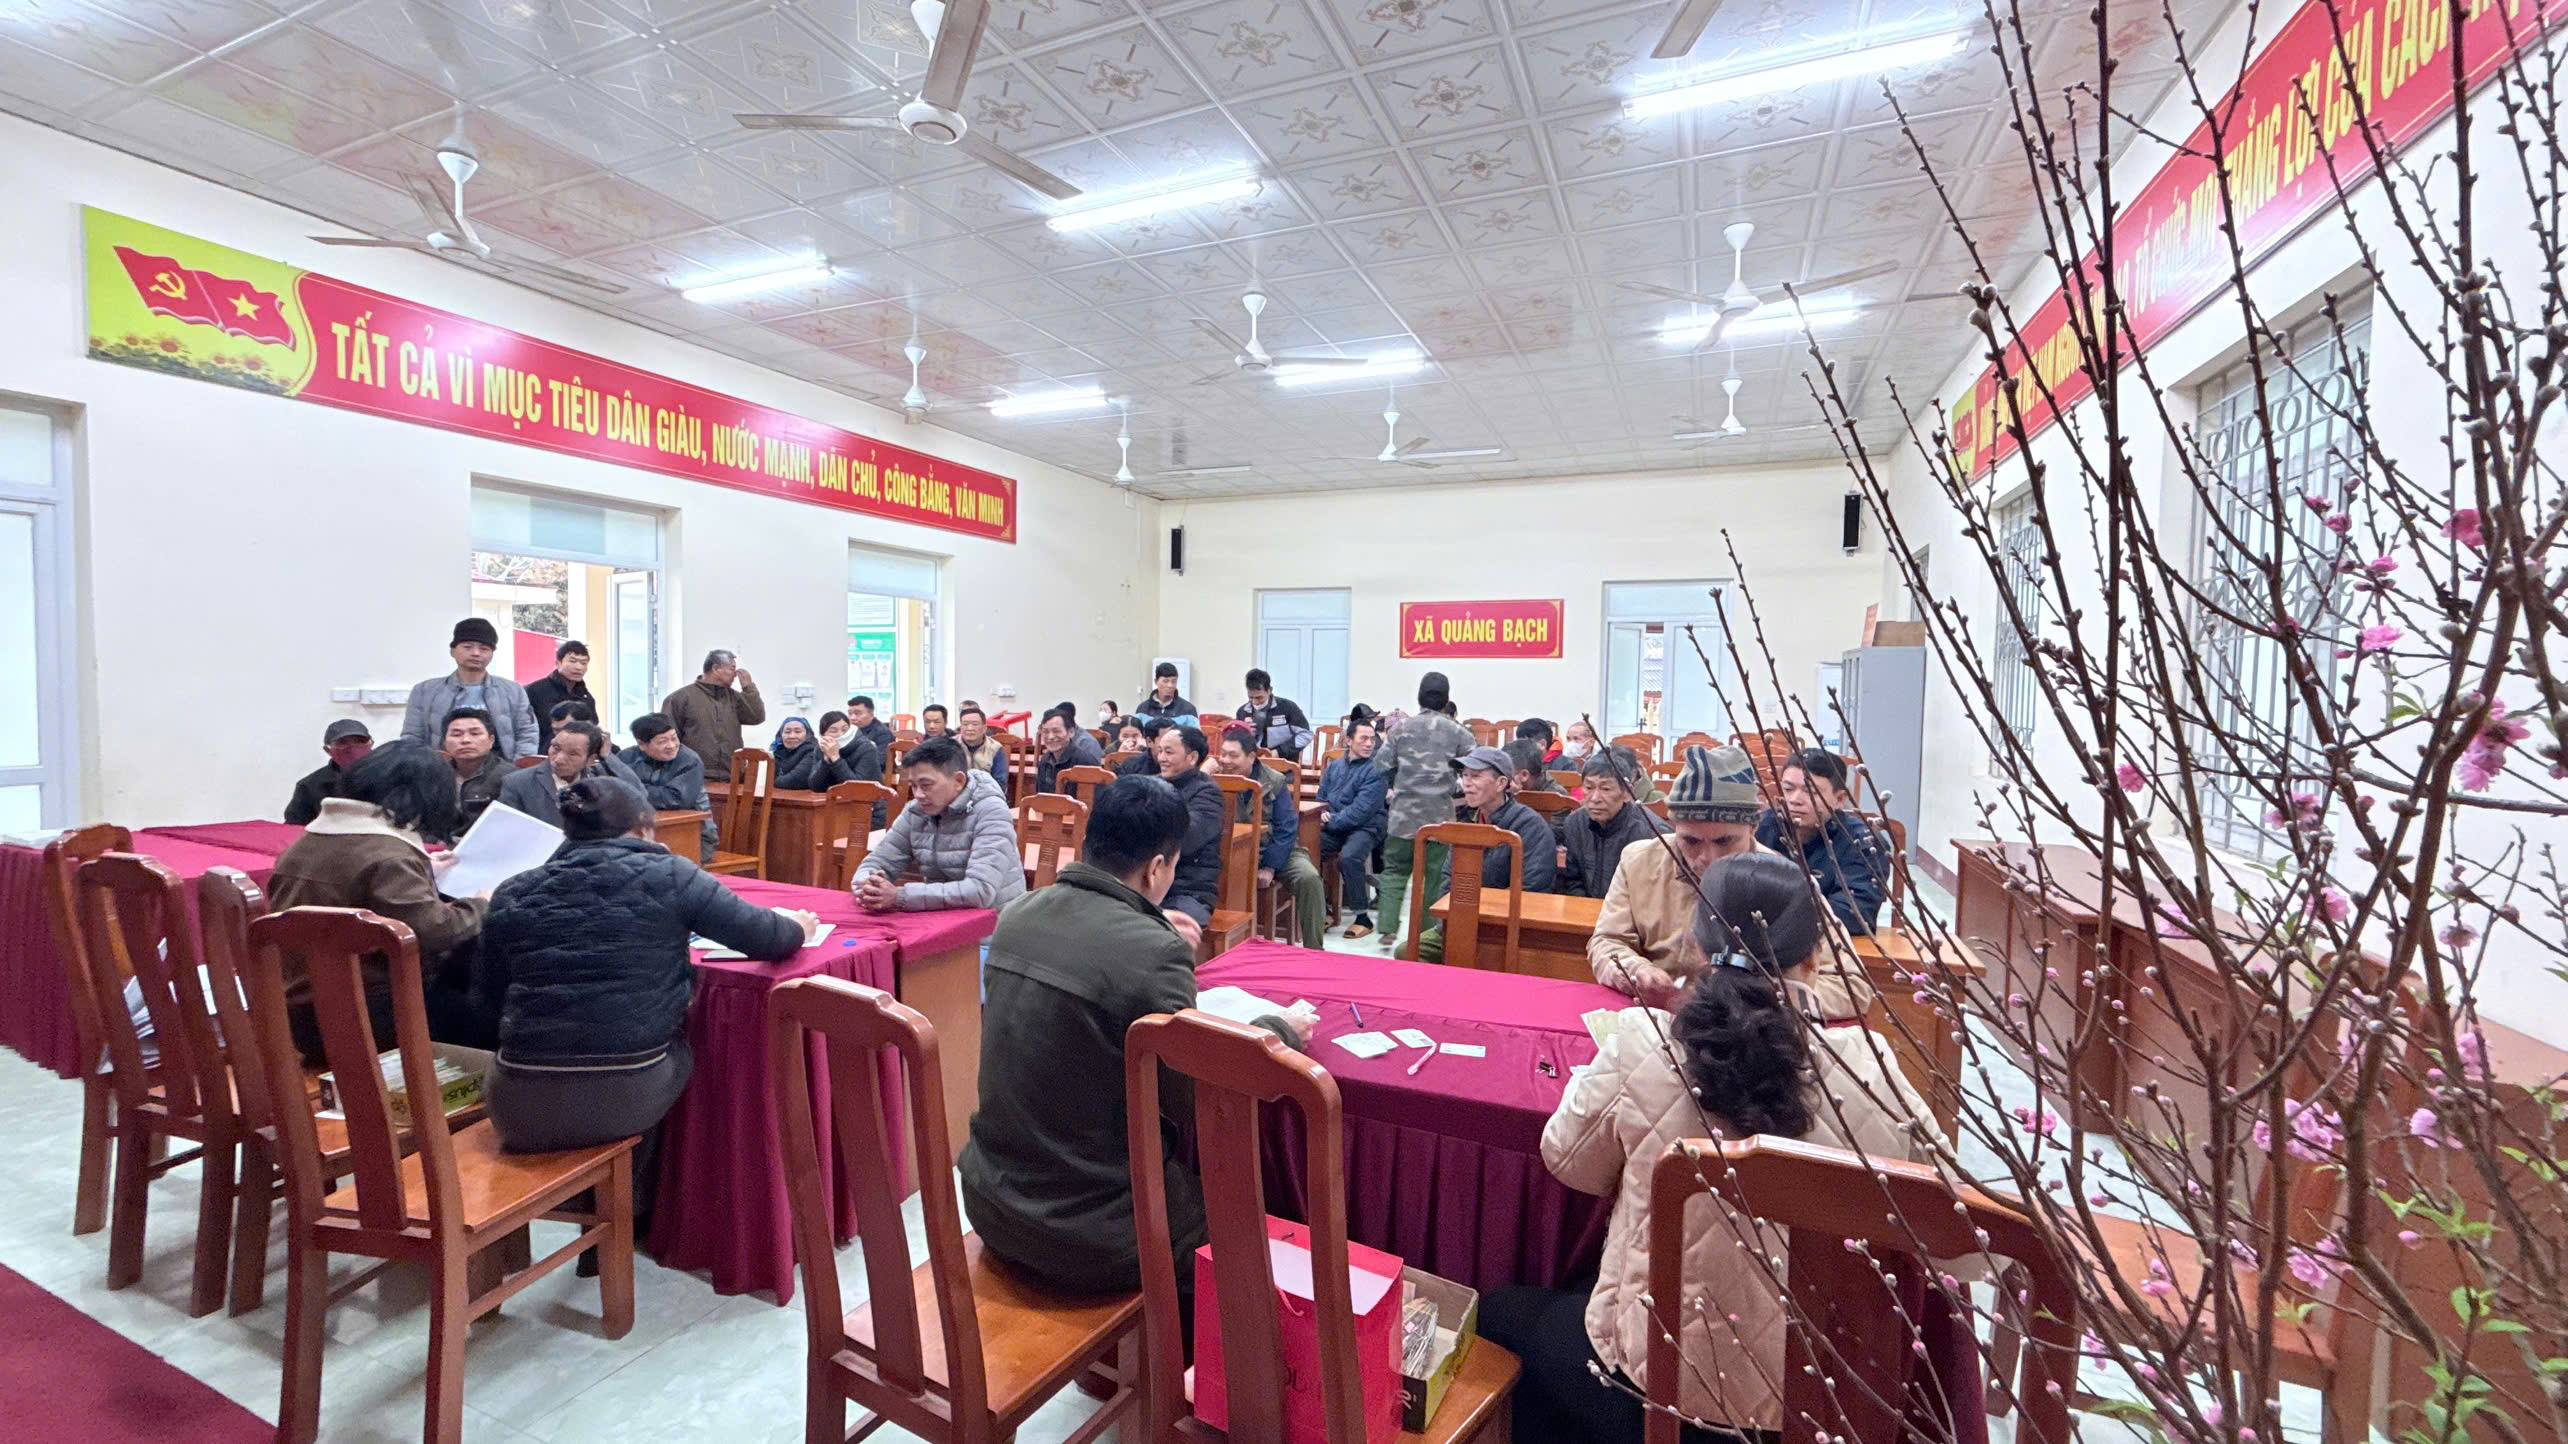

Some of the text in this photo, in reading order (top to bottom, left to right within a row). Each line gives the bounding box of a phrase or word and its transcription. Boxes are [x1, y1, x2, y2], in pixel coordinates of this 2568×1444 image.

[331, 310, 1004, 527] TẤT CẢ VÌ MỤC TIÊU DÂN GIÀU, NƯỚC MẠNH, DÂN CHỦ, CÔNG BẰNG, VĂN MINH
[1413, 610, 1548, 647] XÃ QUẢNG BẠCH
